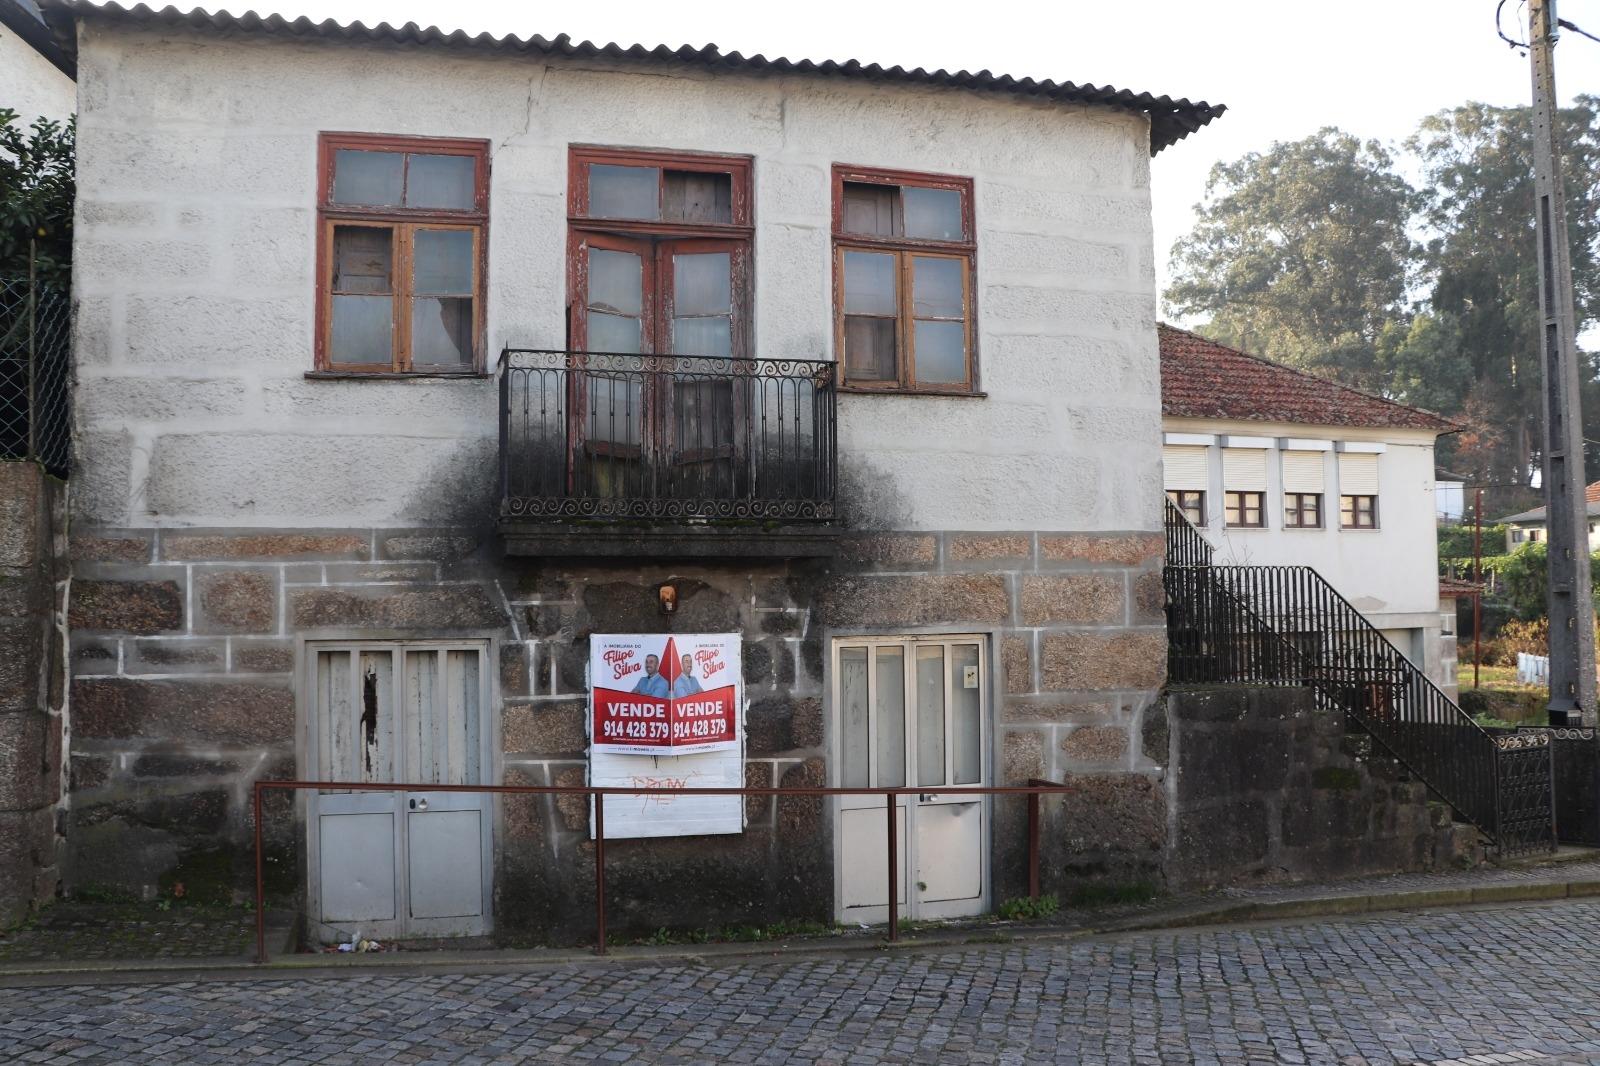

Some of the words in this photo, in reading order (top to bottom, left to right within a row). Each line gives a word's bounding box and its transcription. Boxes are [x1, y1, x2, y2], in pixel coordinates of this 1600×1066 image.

[603, 650, 634, 666] Filipe
[695, 649, 719, 666] Filipe
[614, 662, 642, 680] Silva
[703, 660, 725, 679] Silva
[607, 702, 665, 718] VENDE
[677, 701, 723, 718] VENDE
[603, 721, 623, 737] 914
[626, 721, 646, 738] 428
[649, 722, 669, 738] 379
[673, 721, 690, 738] 914
[692, 720, 708, 736] 428
[710, 719, 726, 734] 379
